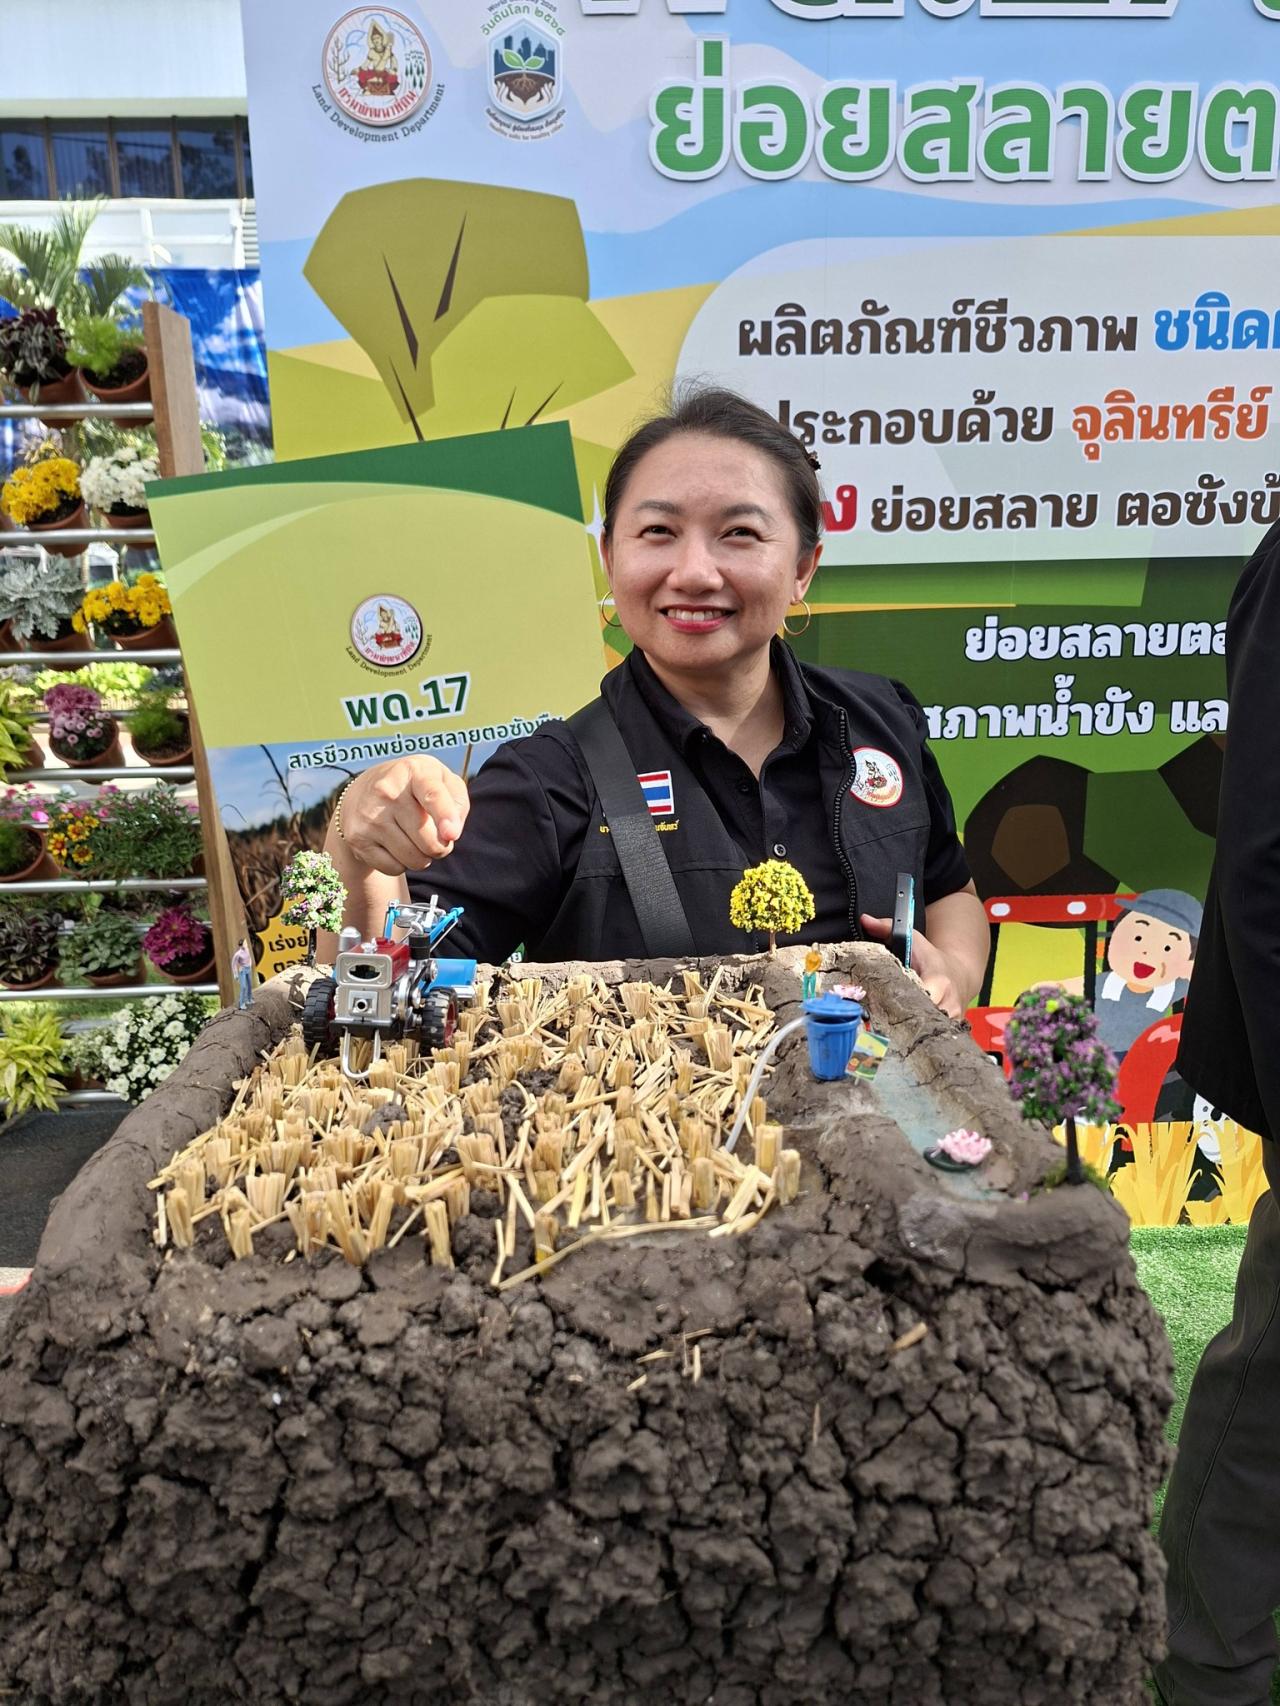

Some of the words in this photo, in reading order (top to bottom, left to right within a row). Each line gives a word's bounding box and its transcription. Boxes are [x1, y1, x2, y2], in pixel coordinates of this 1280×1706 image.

[312, 84, 331, 114] Land
[330, 112, 399, 143] Development
[401, 84, 446, 137] Department
[737, 298, 1139, 357] ผลิตภัณฑ์ชีวภาพ
[1154, 292, 1280, 352] ชนิด
[1071, 386, 1273, 462] จุลินทรีย์
[870, 486, 1099, 533] ย่อยสลาย
[346, 646, 360, 664] Land
[360, 662, 408, 678] Development
[345, 675, 469, 728] พด.17
